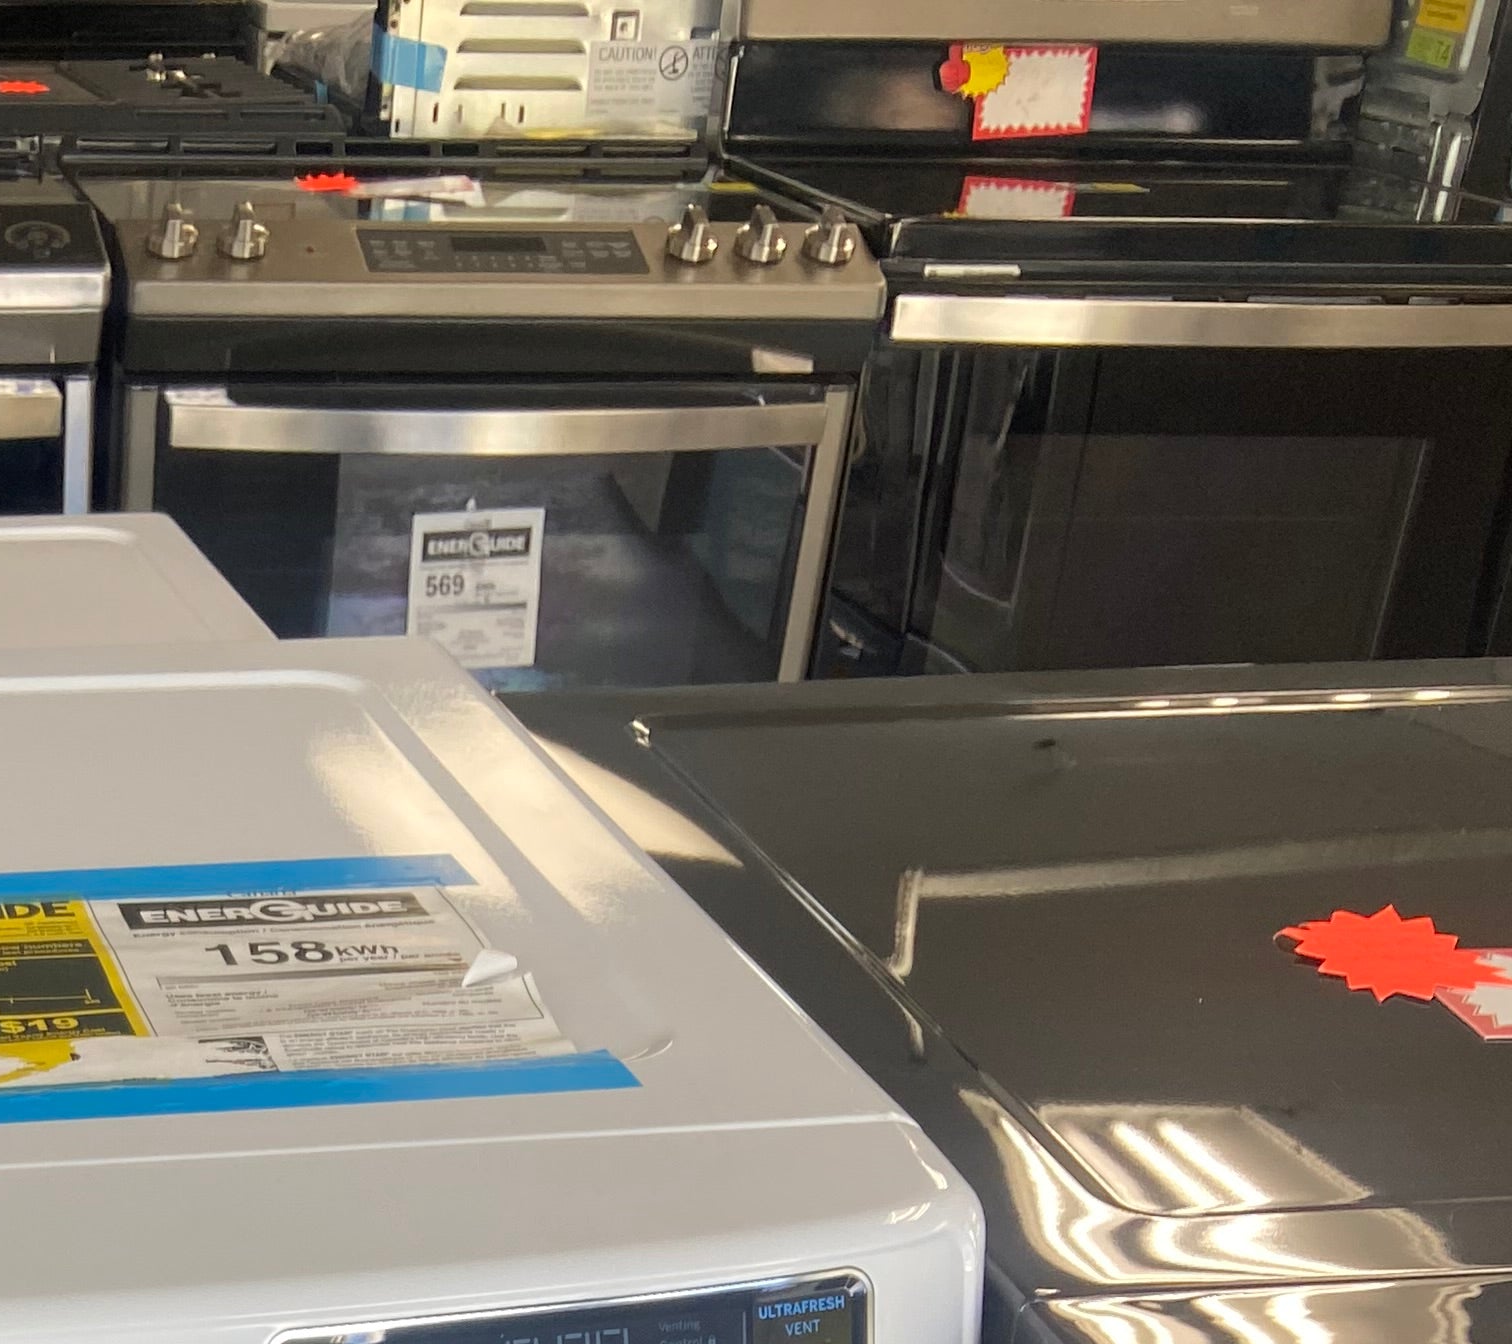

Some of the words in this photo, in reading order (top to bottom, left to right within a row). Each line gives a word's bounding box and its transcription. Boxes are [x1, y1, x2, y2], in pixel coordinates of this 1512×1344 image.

[599, 45, 657, 61] CAUTION!
[425, 574, 465, 597] 569
[204, 941, 334, 966] 158
[336, 944, 399, 956] kWh
[0, 1018, 79, 1034] $19
[758, 1295, 845, 1320] ULTRAFRESH
[785, 1319, 821, 1337] VENT
